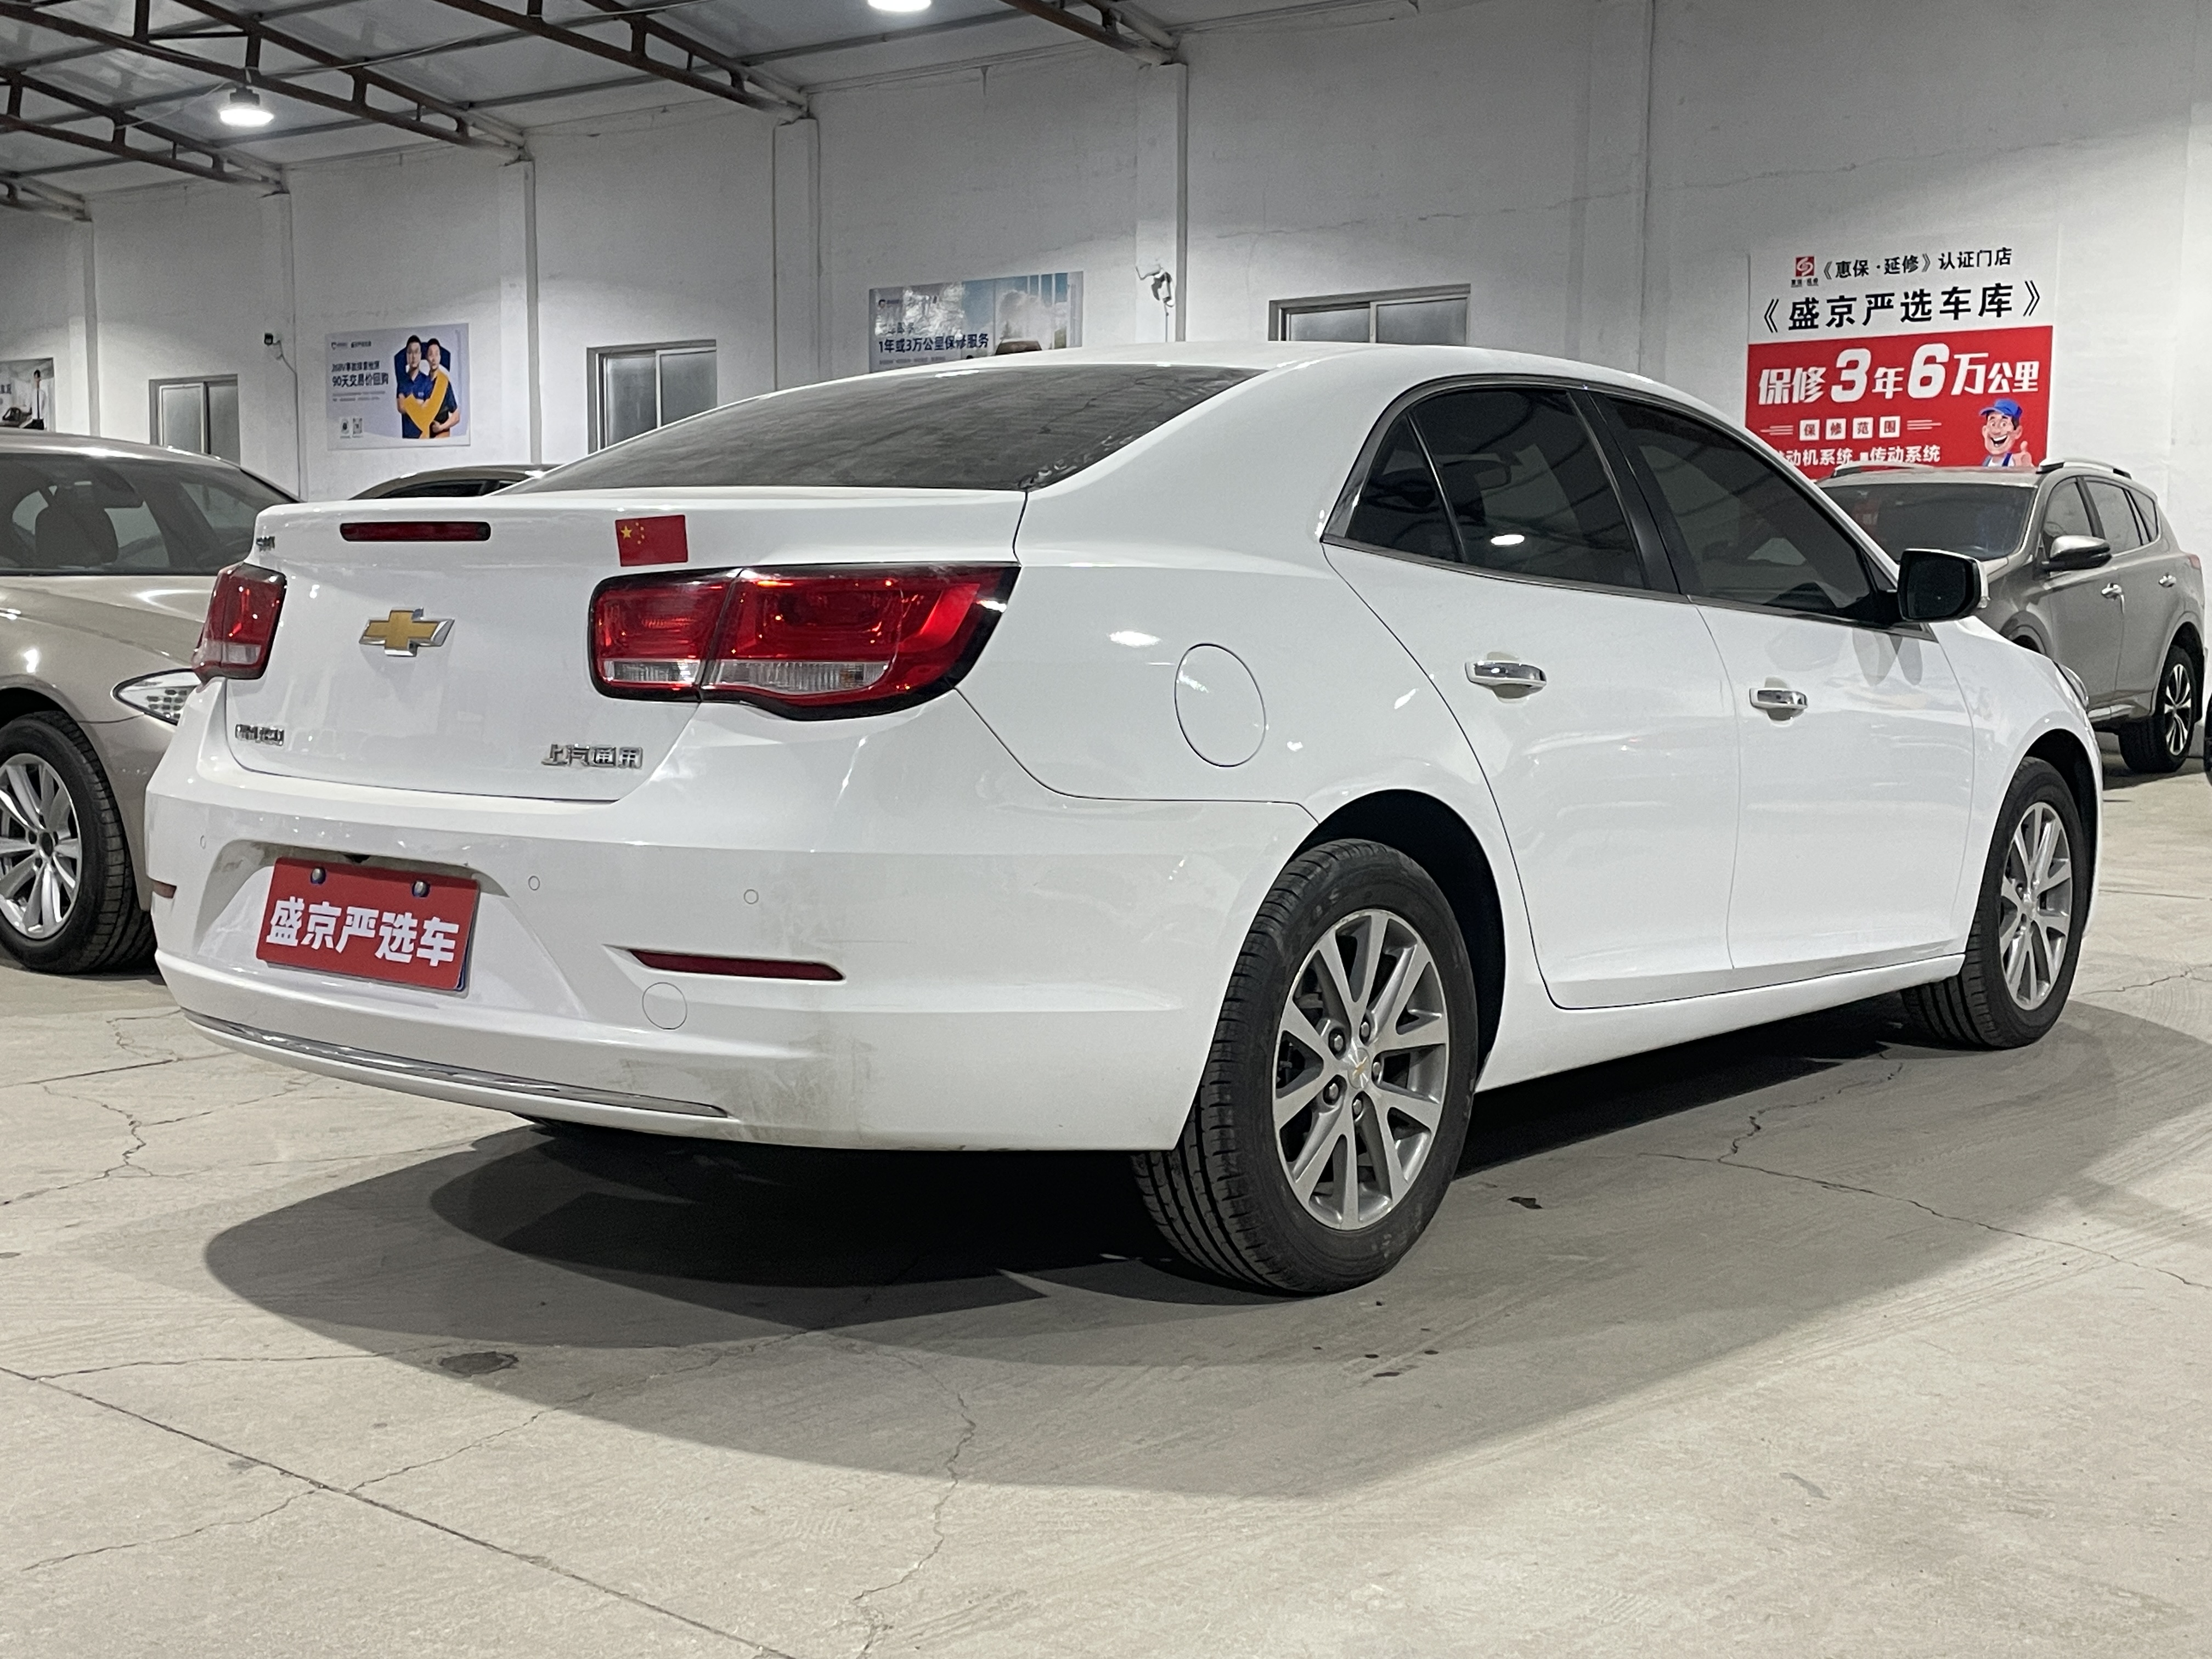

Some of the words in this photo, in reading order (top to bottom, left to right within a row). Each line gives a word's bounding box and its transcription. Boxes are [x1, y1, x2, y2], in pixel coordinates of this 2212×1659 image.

[1764, 280, 2040, 333] 《盛京严选车库》
[1758, 343, 2040, 405] 保修3年6万公里
[1778, 448, 1853, 467] 动机系统
[266, 896, 459, 967] 盛京严选车
